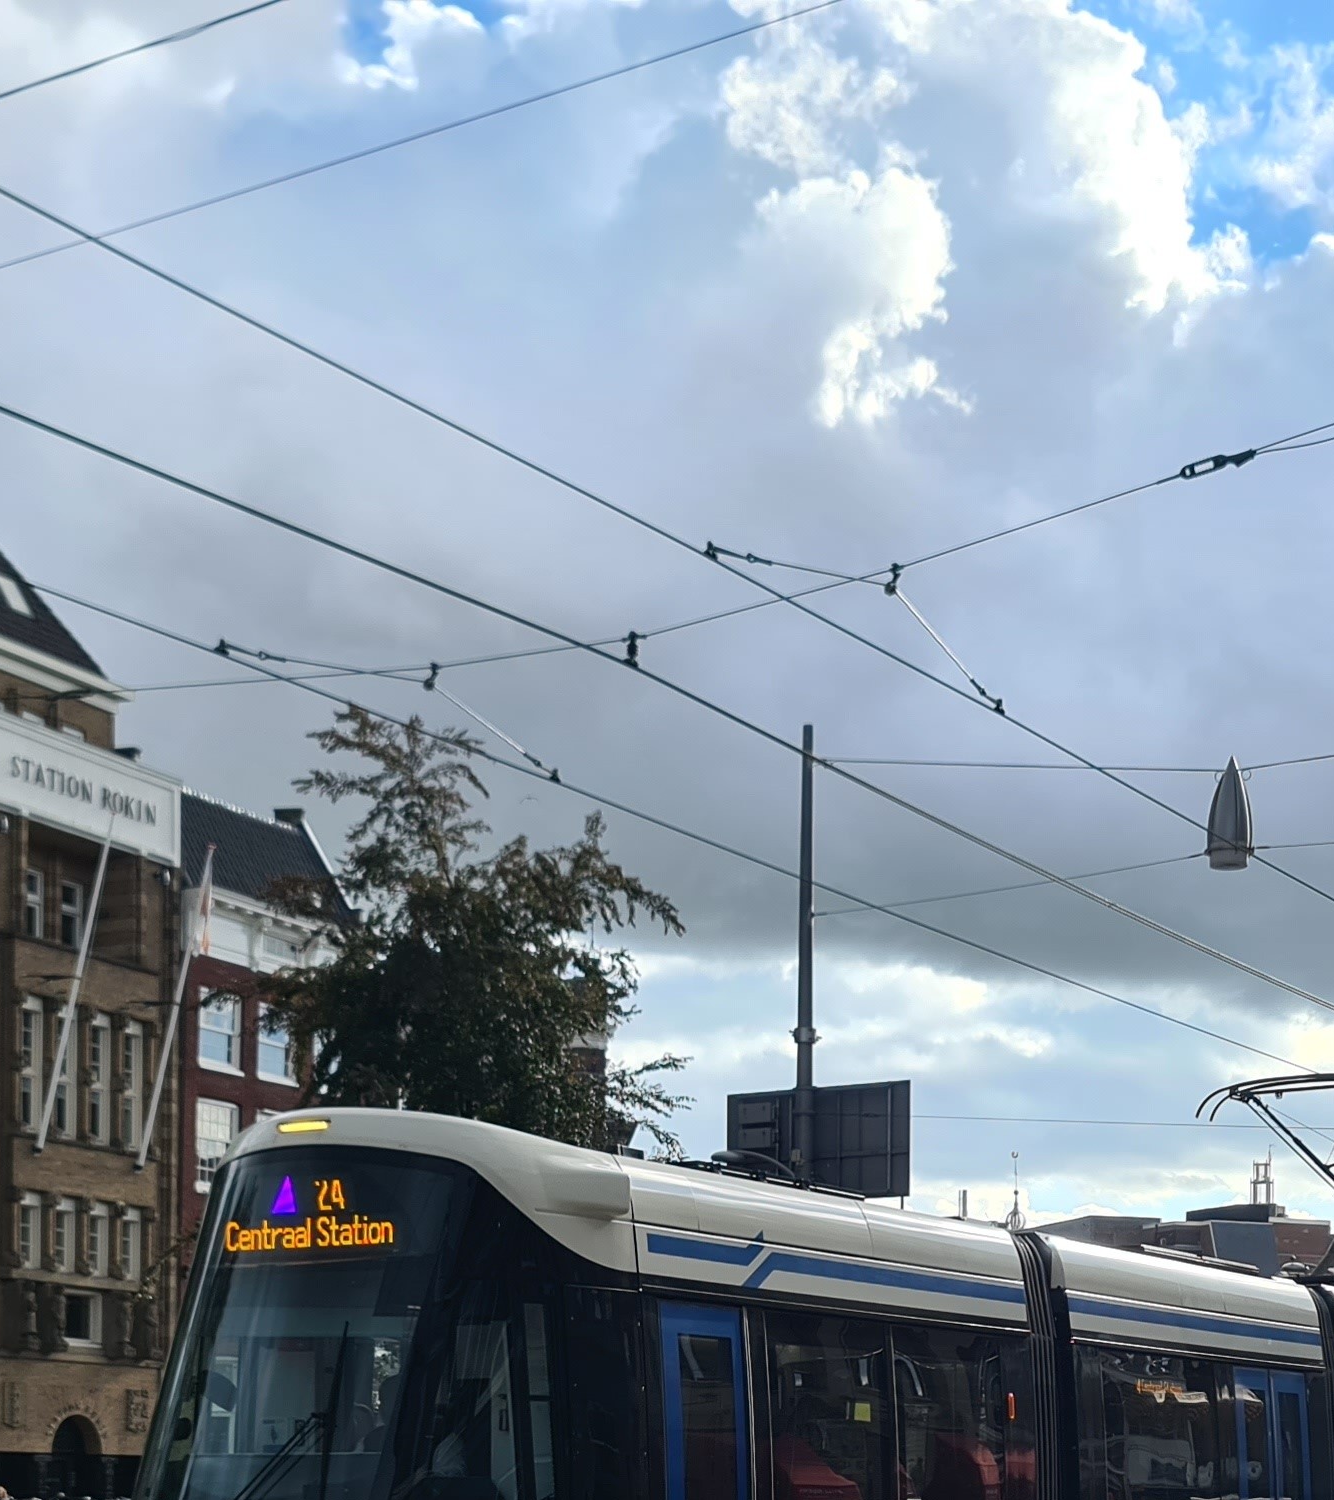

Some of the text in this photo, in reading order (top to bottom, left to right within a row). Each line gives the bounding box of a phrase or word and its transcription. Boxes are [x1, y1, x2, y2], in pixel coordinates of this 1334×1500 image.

[11, 756, 157, 827] STATION ROKIN
[315, 1179, 345, 1211] 24
[226, 1214, 394, 1251] Centraal Station
